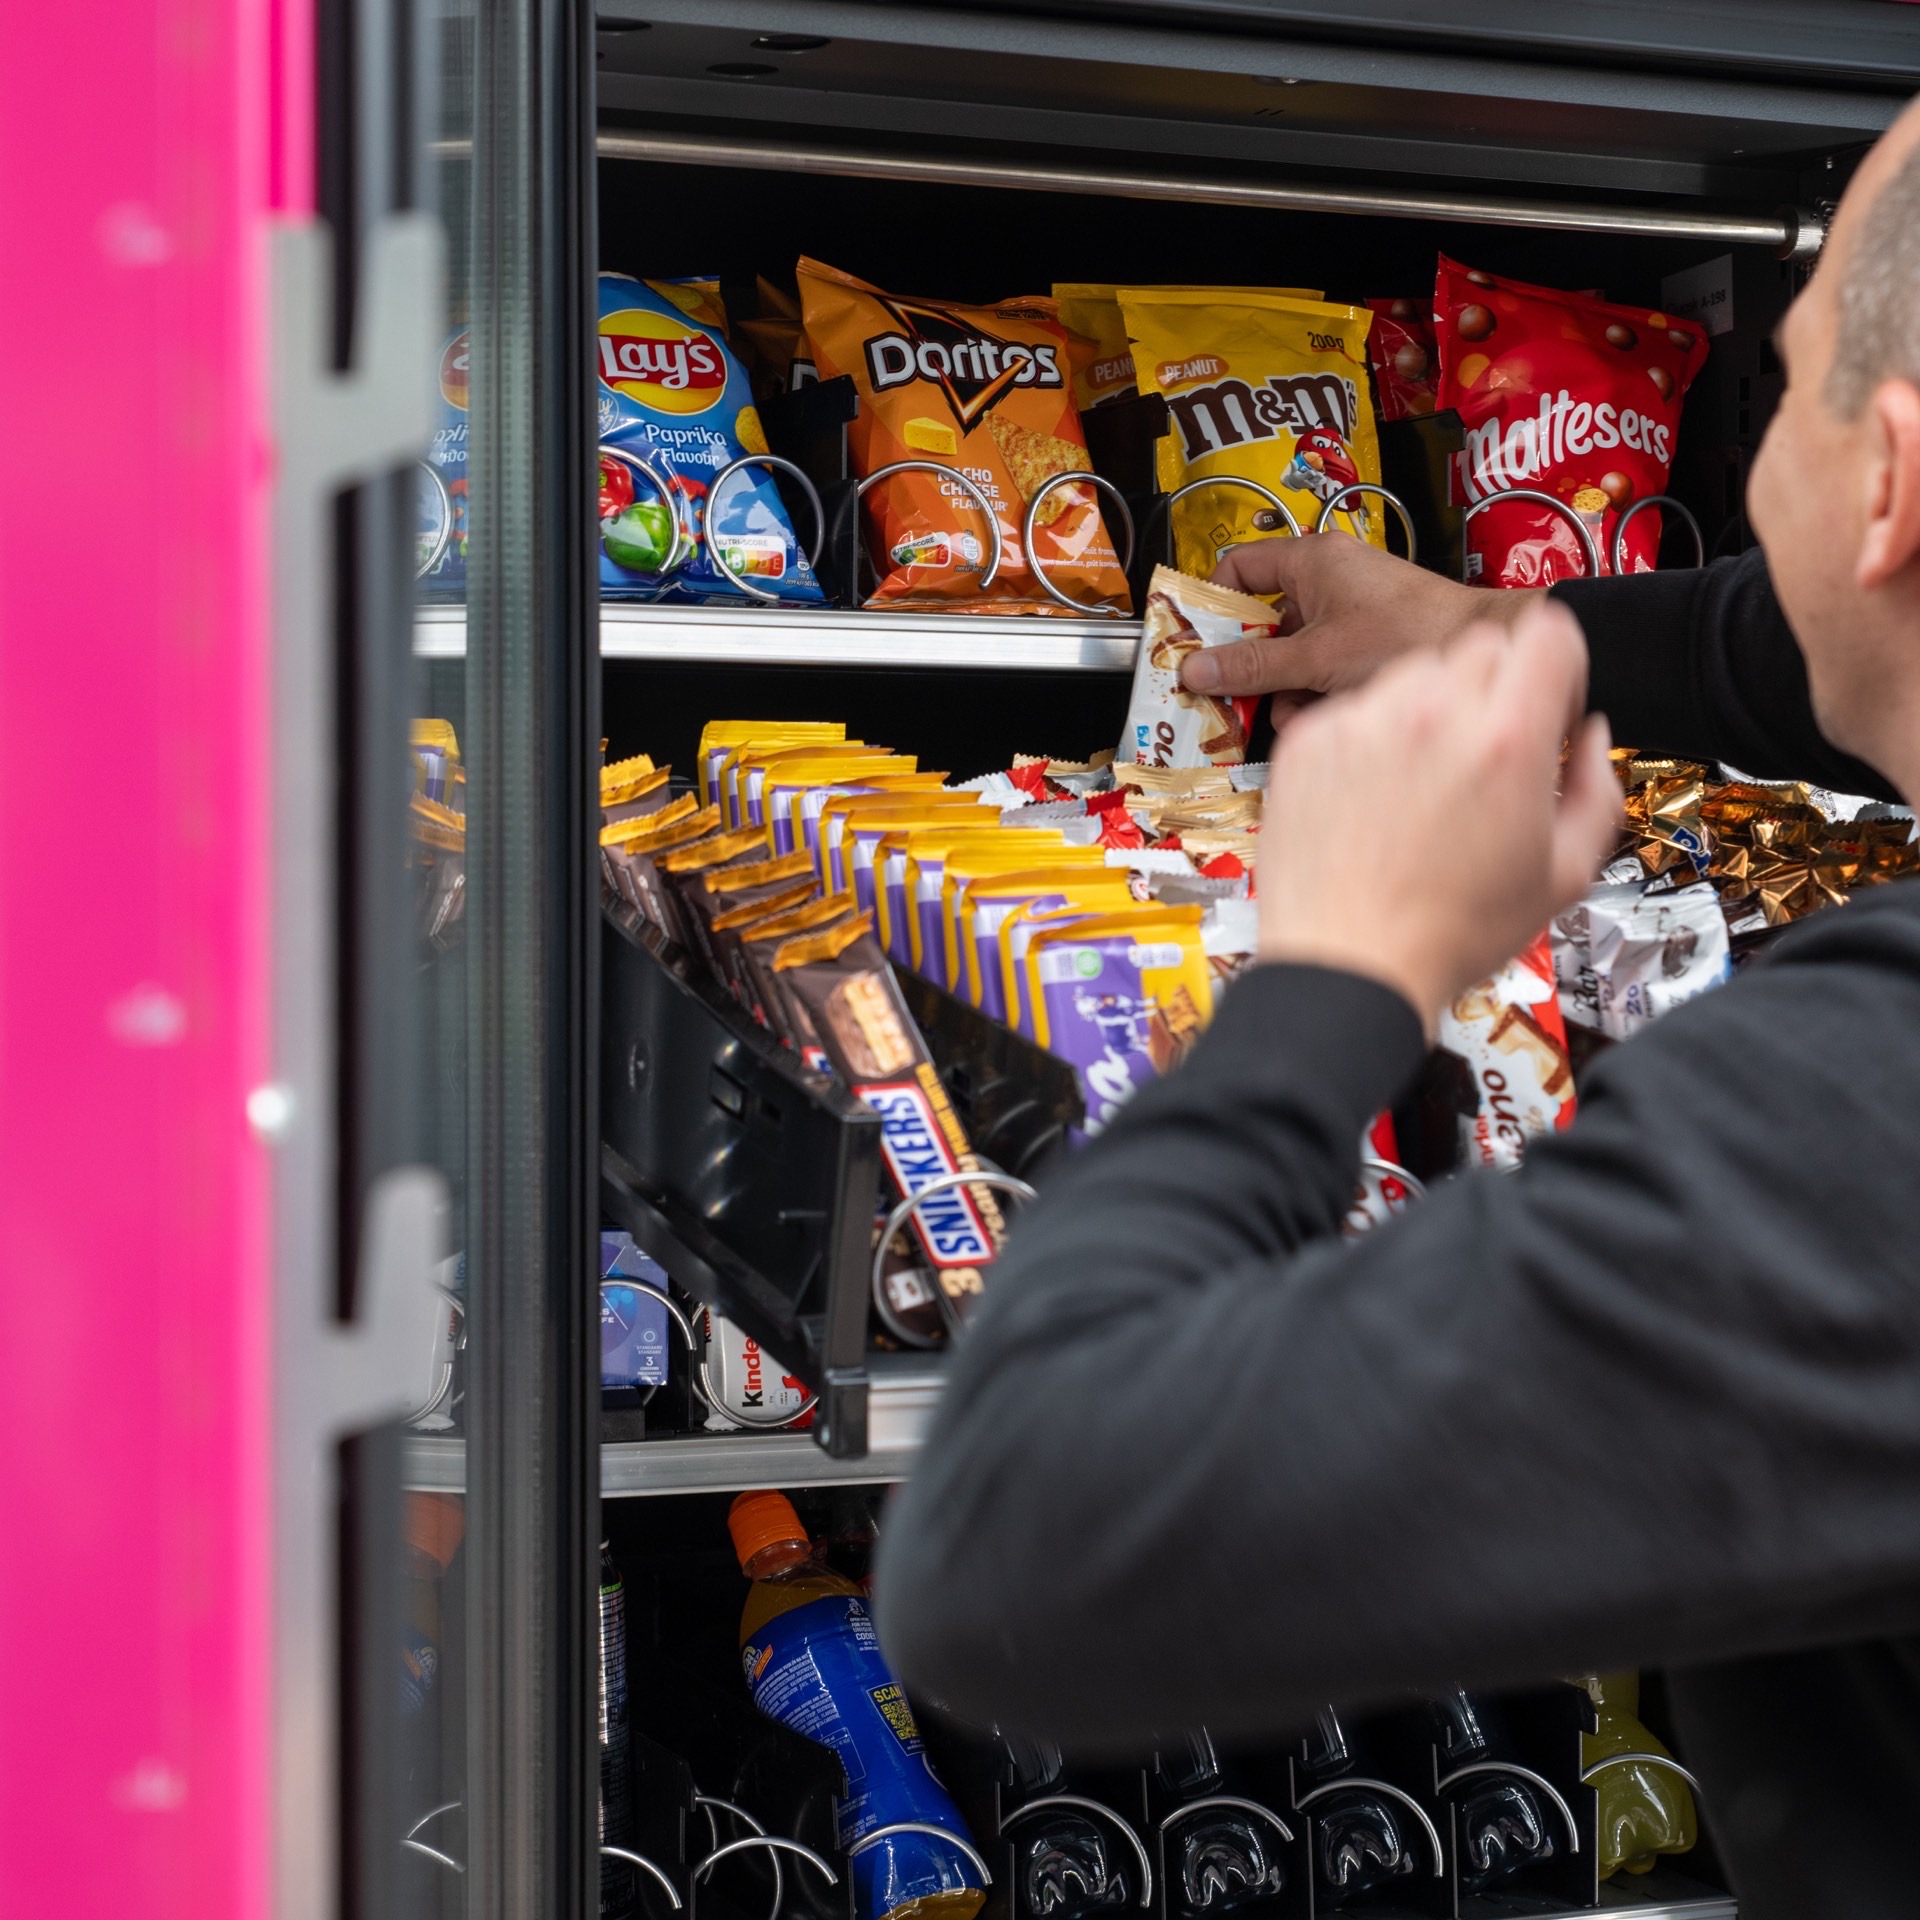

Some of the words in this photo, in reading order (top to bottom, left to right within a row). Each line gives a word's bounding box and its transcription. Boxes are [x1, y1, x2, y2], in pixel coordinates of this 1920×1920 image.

[1307, 331, 1344, 353] 200g
[599, 335, 716, 390] Lay's
[869, 337, 1062, 388] Doritos
[1165, 358, 1219, 381] PEANUT
[645, 424, 727, 448] Paprika
[661, 447, 720, 466] Flavour
[1573, 964, 1599, 1013] Bar
[1626, 984, 1643, 1015] 20
[645, 1356, 654, 1366] 3
[741, 1334, 764, 1408] Kinde
